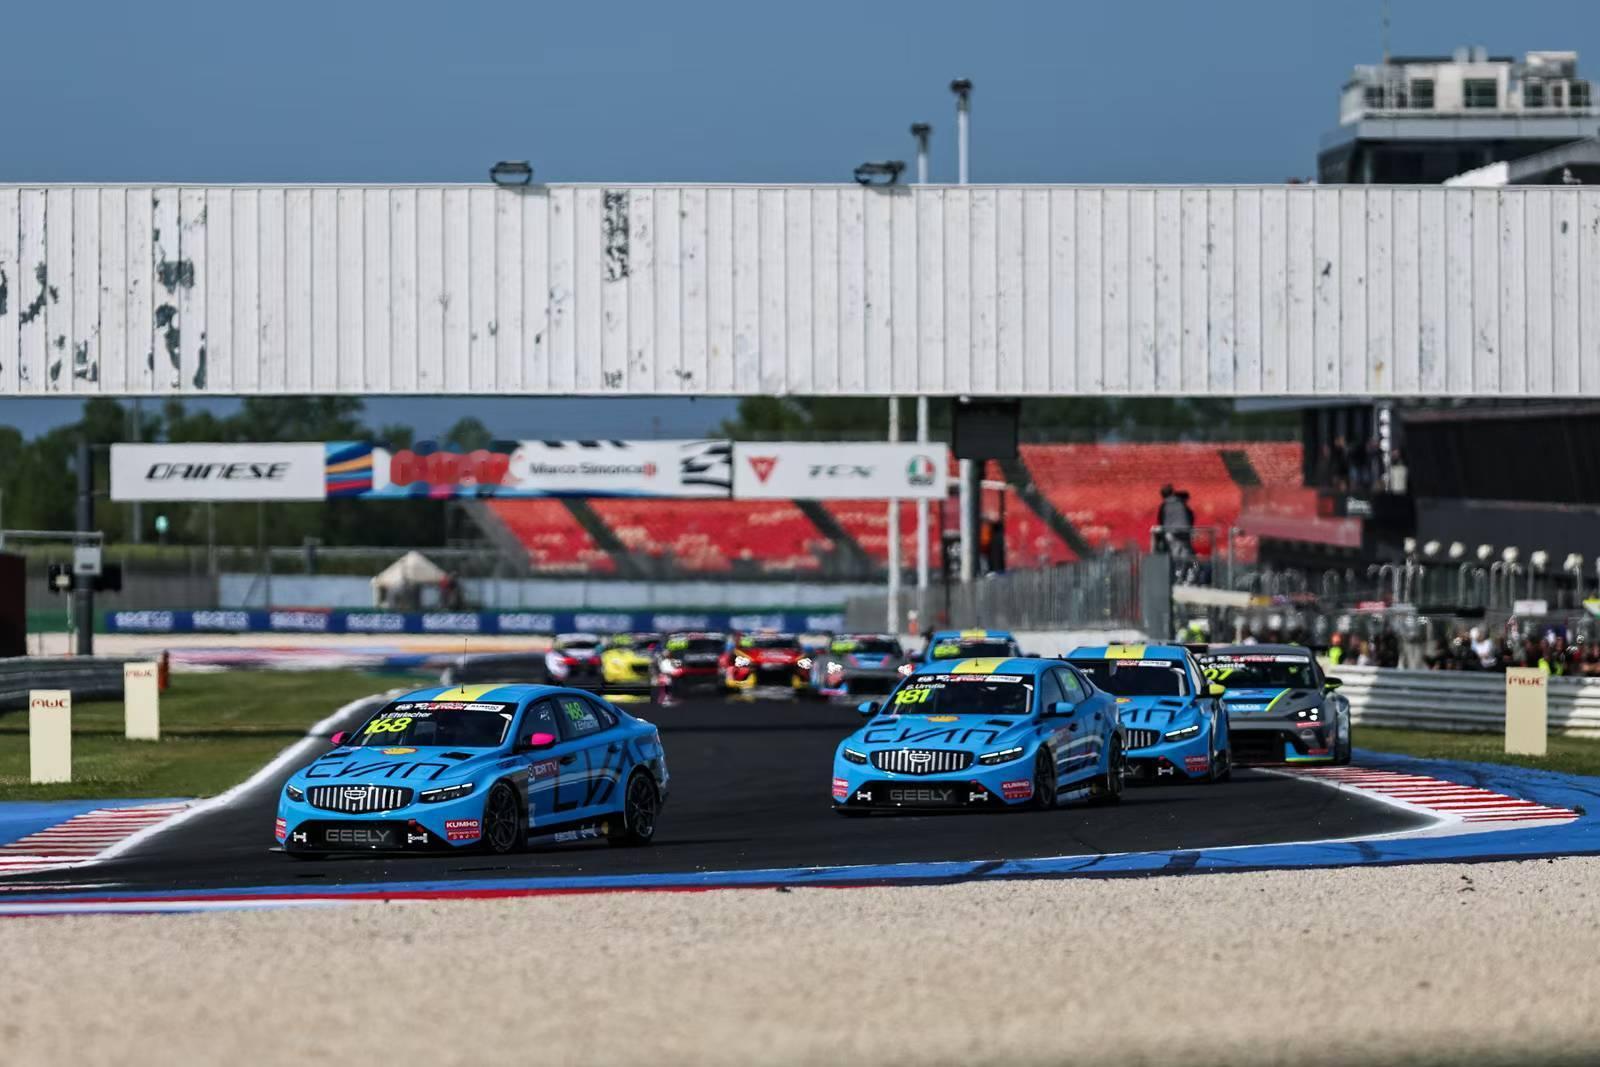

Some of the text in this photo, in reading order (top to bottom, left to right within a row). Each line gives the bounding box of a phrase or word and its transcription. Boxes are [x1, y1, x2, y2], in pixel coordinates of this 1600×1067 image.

[894, 688, 931, 704] 181
[364, 717, 412, 734] 168
[889, 789, 953, 801] GEELY
[446, 820, 479, 829] KUMHO
[325, 829, 391, 842] GEELY
